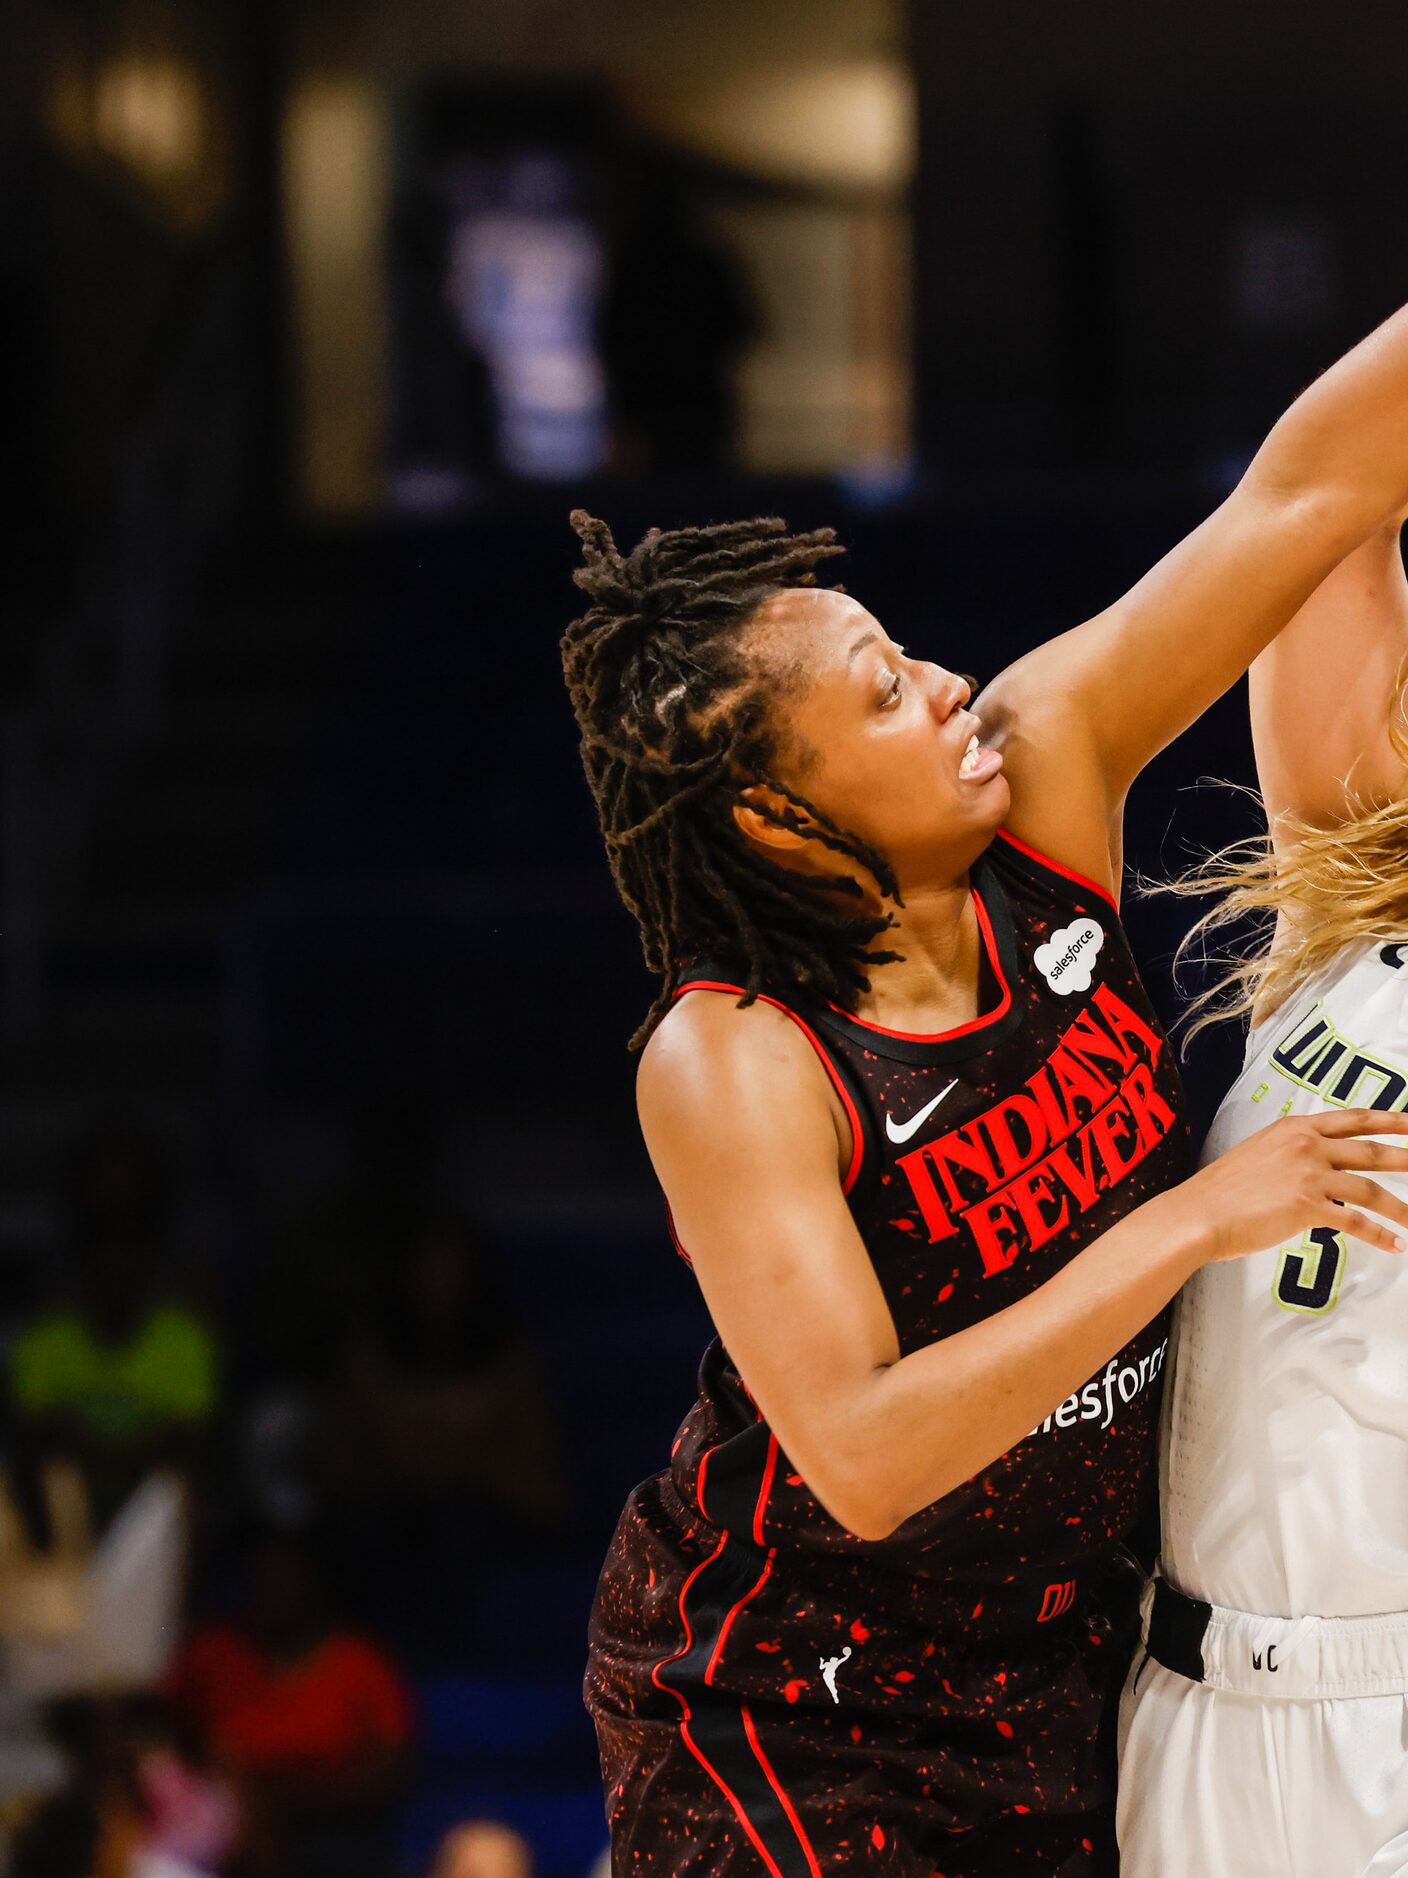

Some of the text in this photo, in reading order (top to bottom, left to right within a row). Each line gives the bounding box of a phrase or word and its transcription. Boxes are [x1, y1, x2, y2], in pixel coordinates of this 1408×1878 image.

[1050, 926, 1095, 981] salesforce
[896, 981, 1163, 1244] INDIANA
[960, 1062, 1176, 1280] FEVER
